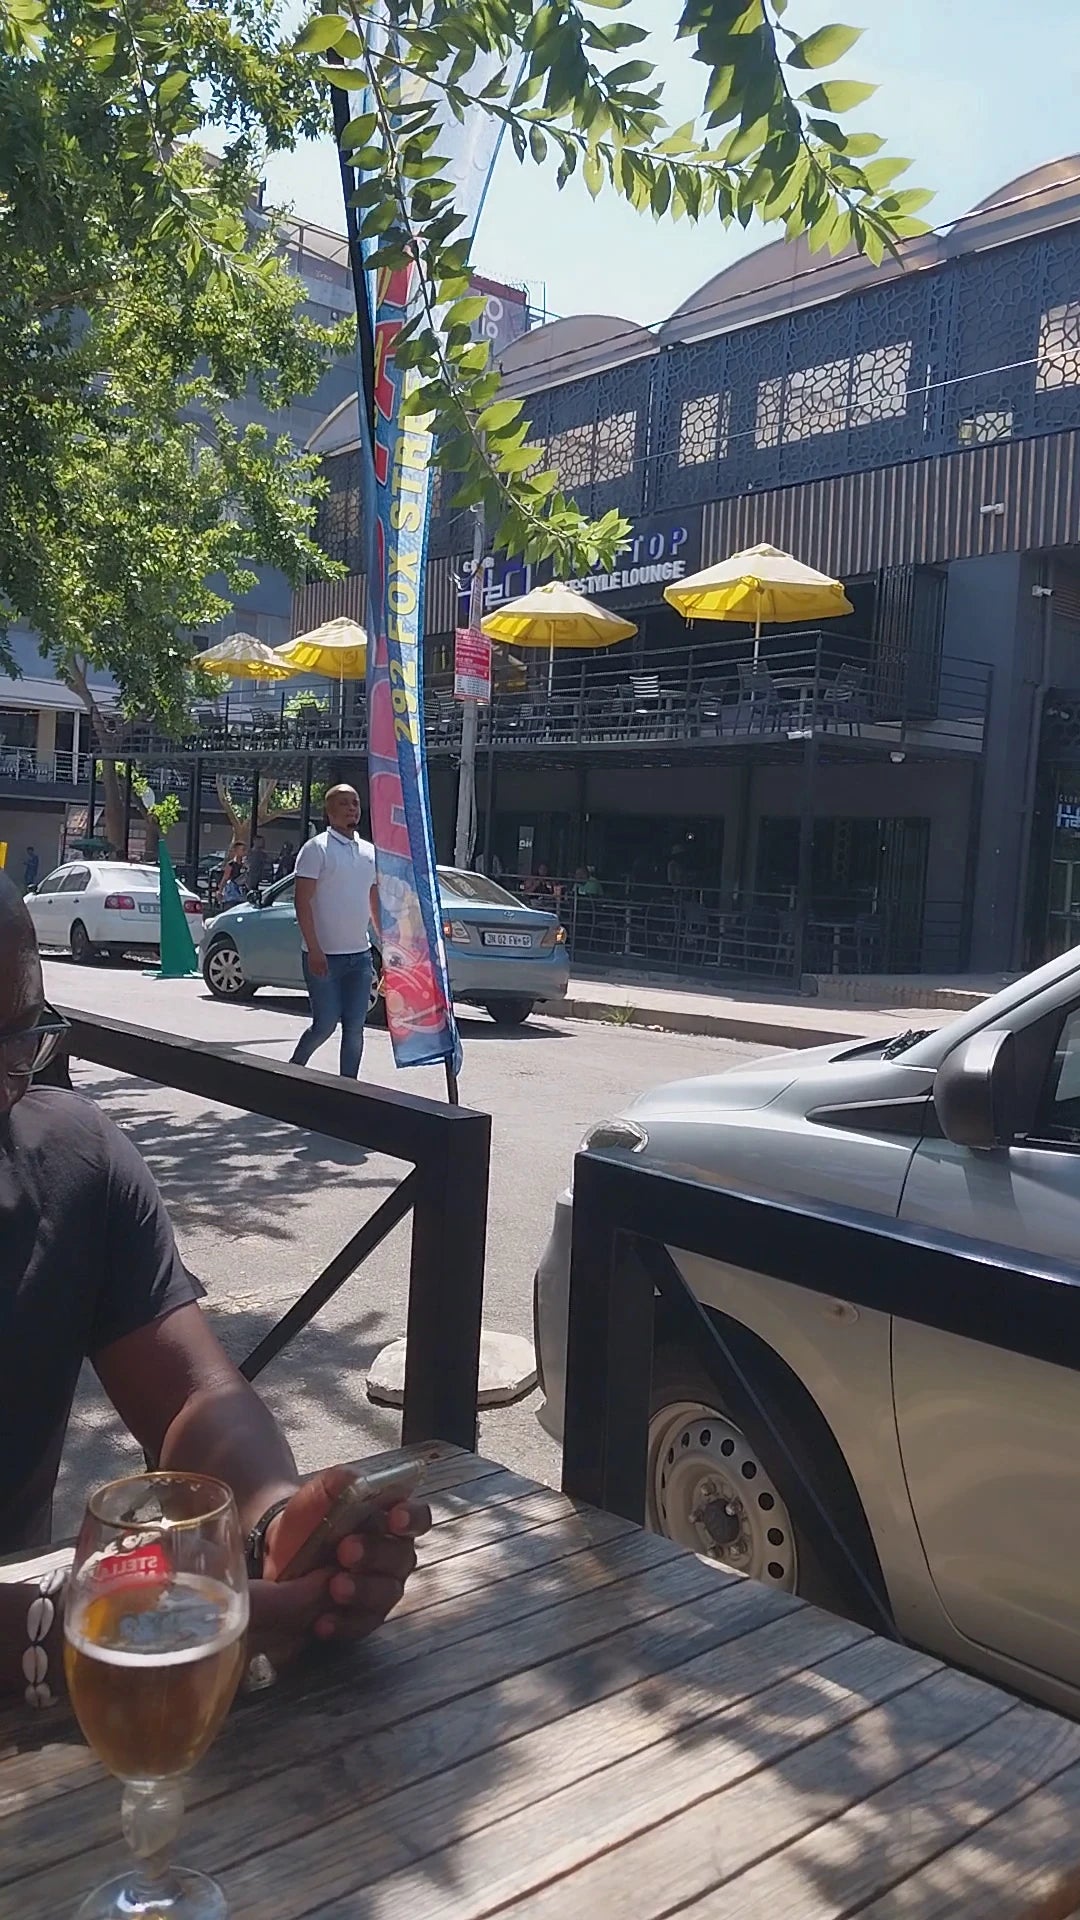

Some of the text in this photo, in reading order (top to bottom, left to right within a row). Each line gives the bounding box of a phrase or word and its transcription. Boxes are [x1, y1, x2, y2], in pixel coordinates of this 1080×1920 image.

[388, 545, 419, 647] FOX
[622, 560, 687, 588] LOUNGE
[389, 659, 419, 747] 292
